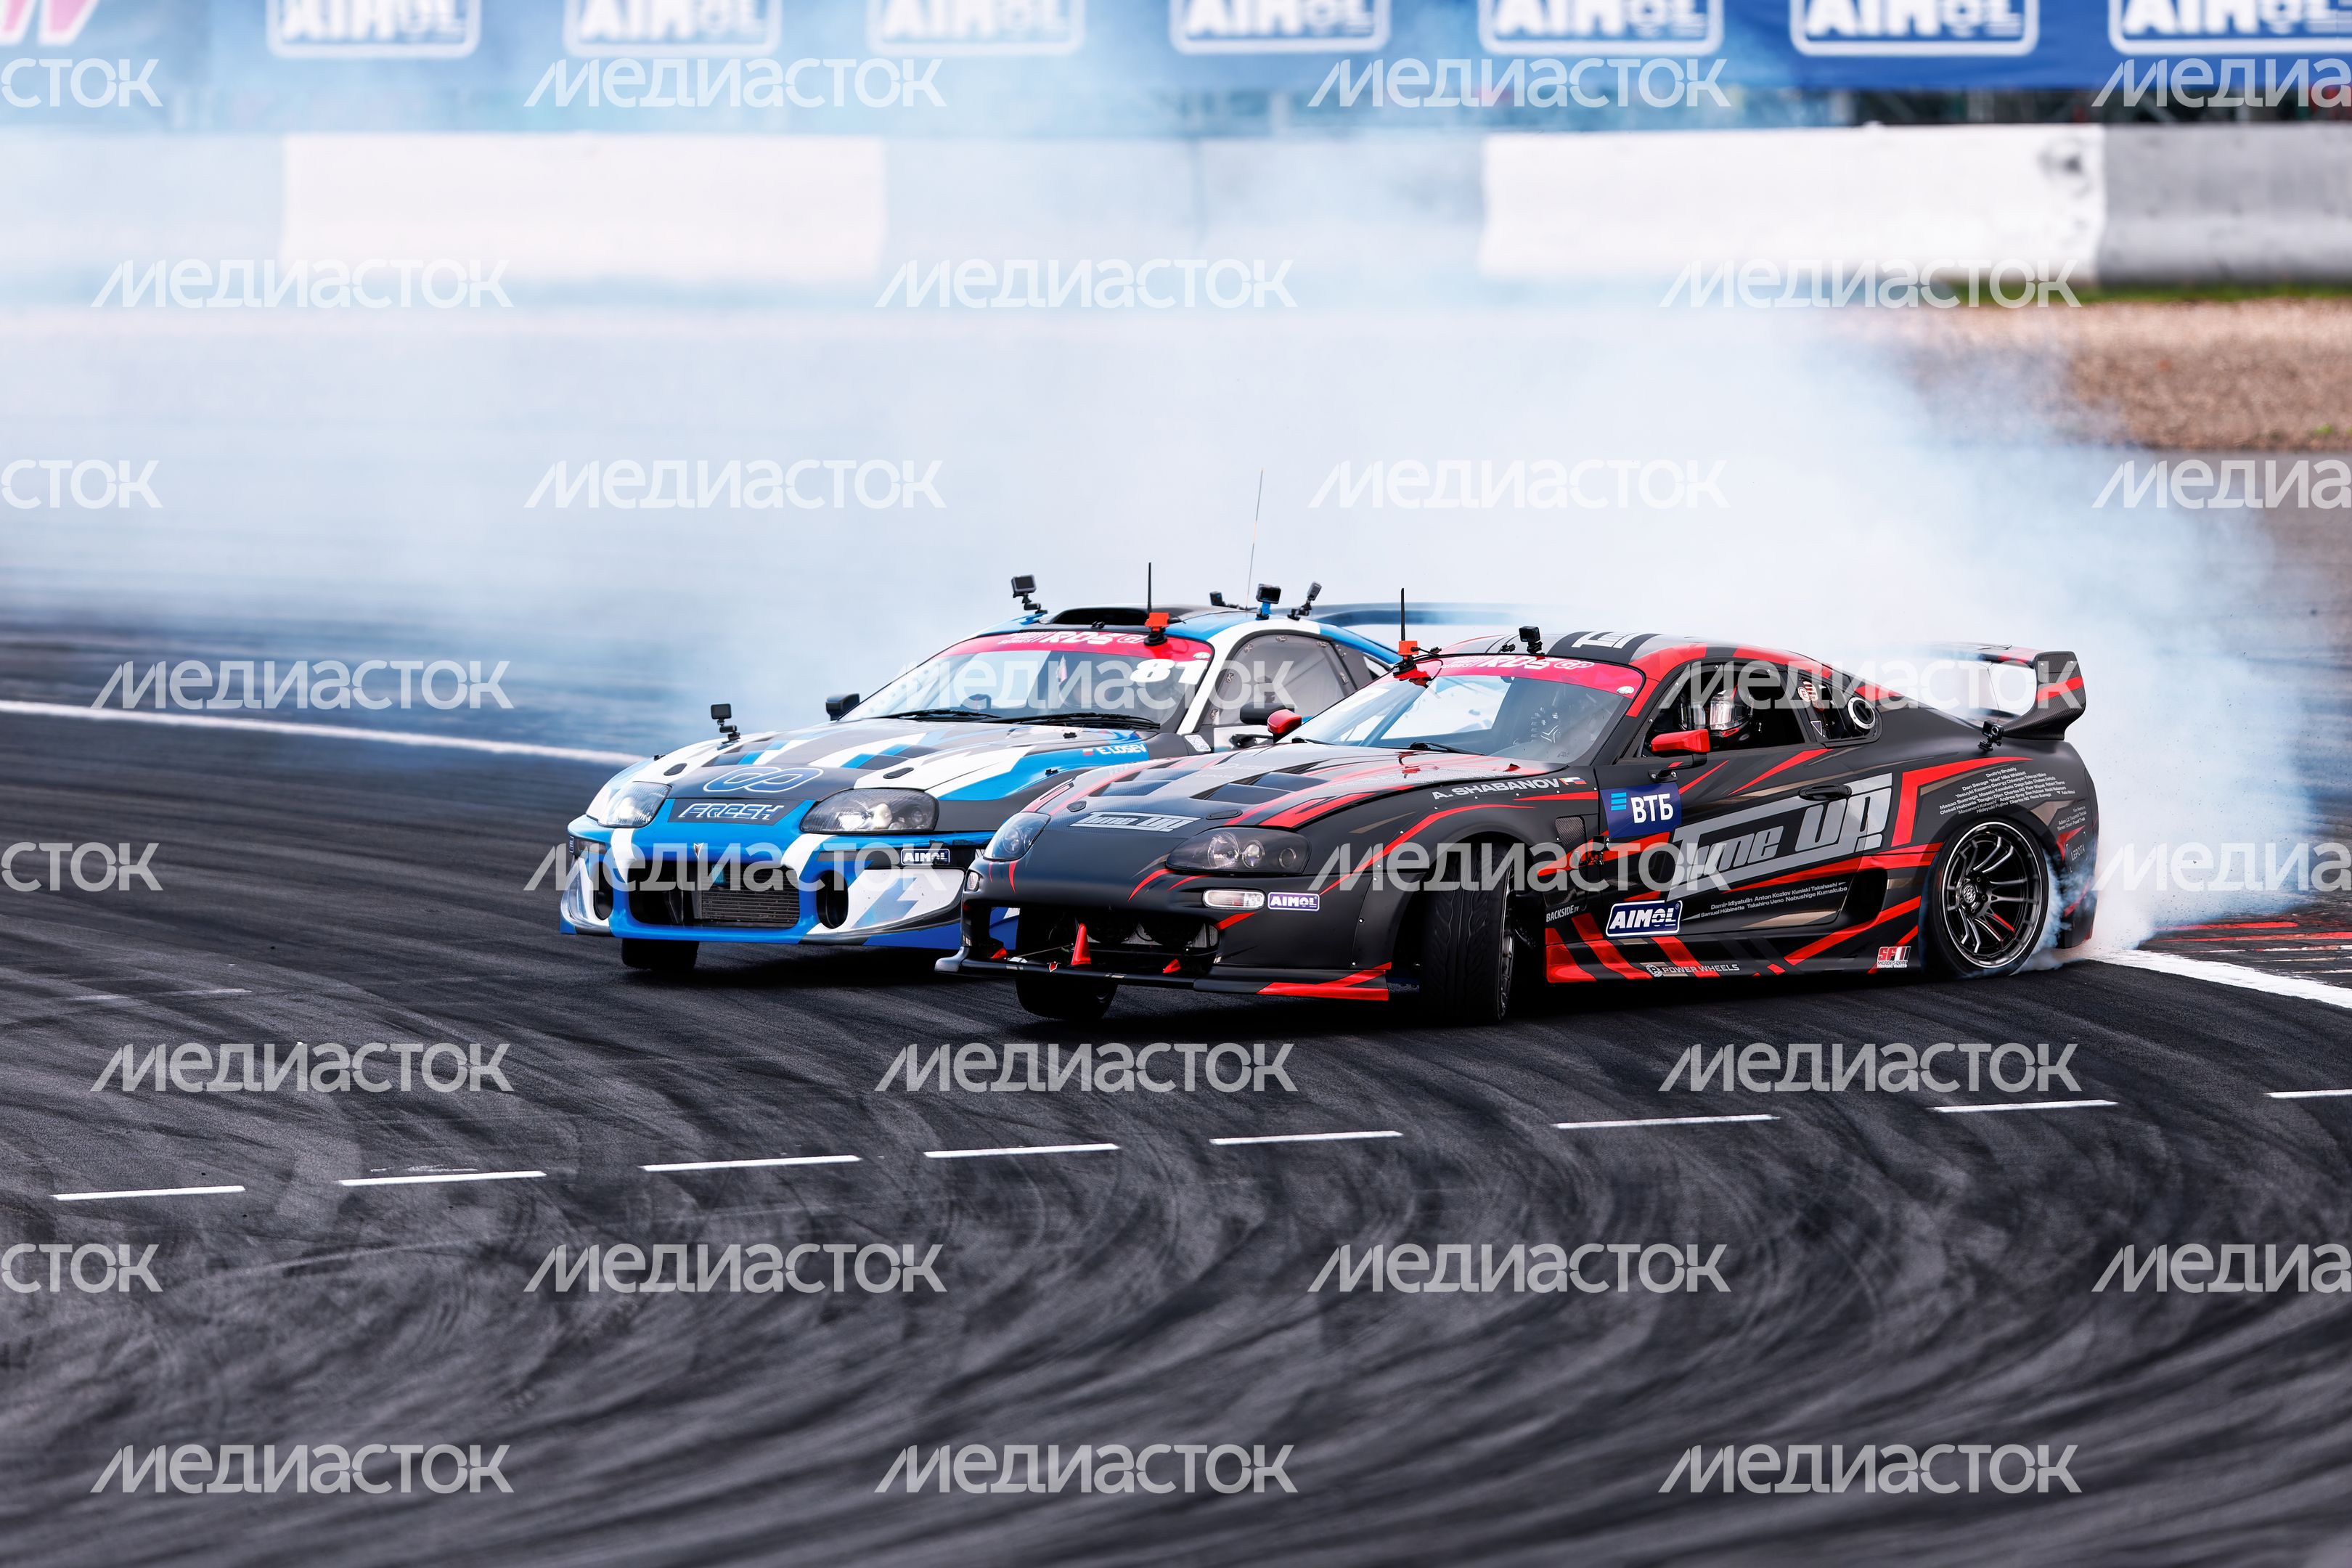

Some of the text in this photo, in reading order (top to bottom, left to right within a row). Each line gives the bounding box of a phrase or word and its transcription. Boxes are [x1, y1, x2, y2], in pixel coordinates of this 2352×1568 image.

[1038, 631, 1127, 645] RDS
[1130, 658, 1209, 685] 81
[1451, 777, 1560, 796] SHABANOV
[1630, 793, 1674, 824] ВТБ
[1772, 890, 1791, 899] Kozlov
[1816, 886, 1848, 897] Kumakubo
[1270, 896, 1318, 907] AIMOL
[1609, 907, 1676, 930] AIMOL
